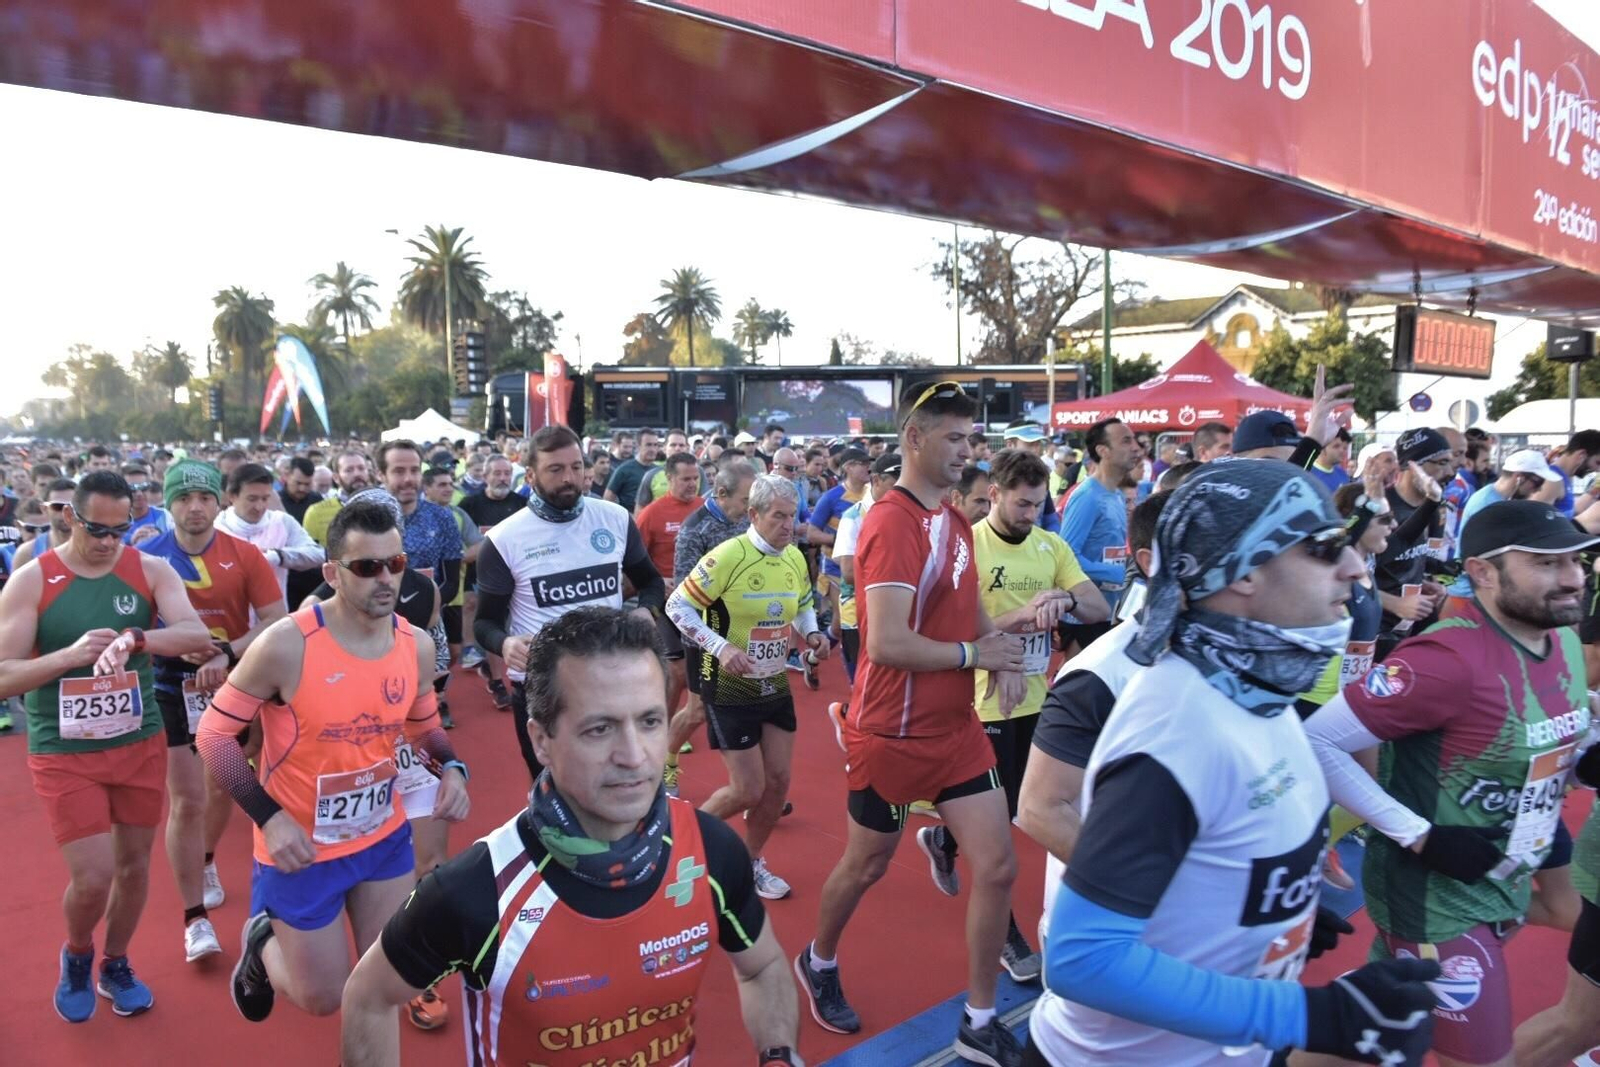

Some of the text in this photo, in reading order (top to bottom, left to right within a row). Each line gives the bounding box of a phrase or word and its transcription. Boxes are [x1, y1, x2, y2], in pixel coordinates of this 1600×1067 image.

[1171, 0, 1311, 100] 2019
[1472, 38, 1543, 143] edp
[1558, 202, 1598, 244] edición
[539, 573, 616, 602] fascino
[92, 679, 112, 692] edp
[74, 692, 131, 719] 2532
[355, 771, 375, 786] edp
[332, 782, 388, 820] 2716
[639, 922, 709, 956] MotorDOS
[539, 995, 693, 1051] Clínicas
